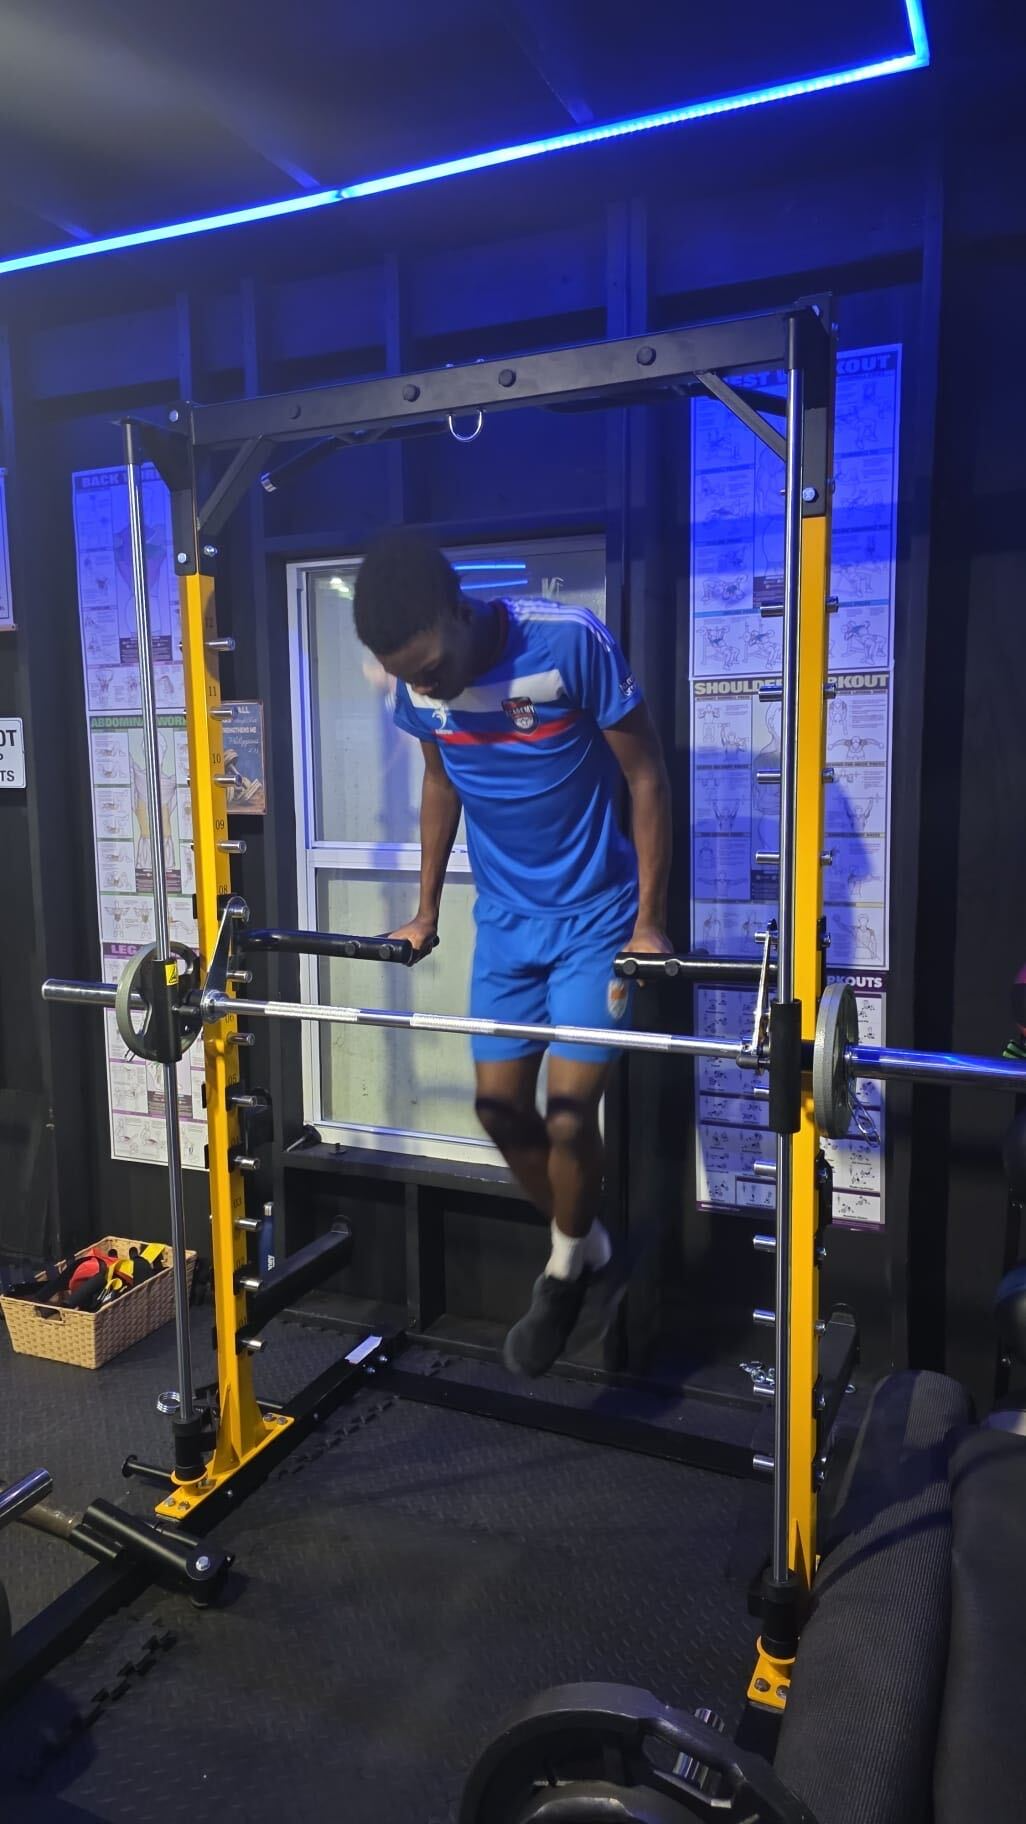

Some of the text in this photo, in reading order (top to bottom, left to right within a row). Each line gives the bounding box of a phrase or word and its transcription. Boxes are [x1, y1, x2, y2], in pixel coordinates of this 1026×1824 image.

[81, 472, 120, 489] BACK
[827, 674, 889, 689] RKOUT
[92, 716, 144, 728] ABDOMIN
[211, 753, 222, 765] 10
[215, 819, 225, 831] 09
[111, 944, 138, 955] LEG
[826, 975, 883, 988] RKOUTS
